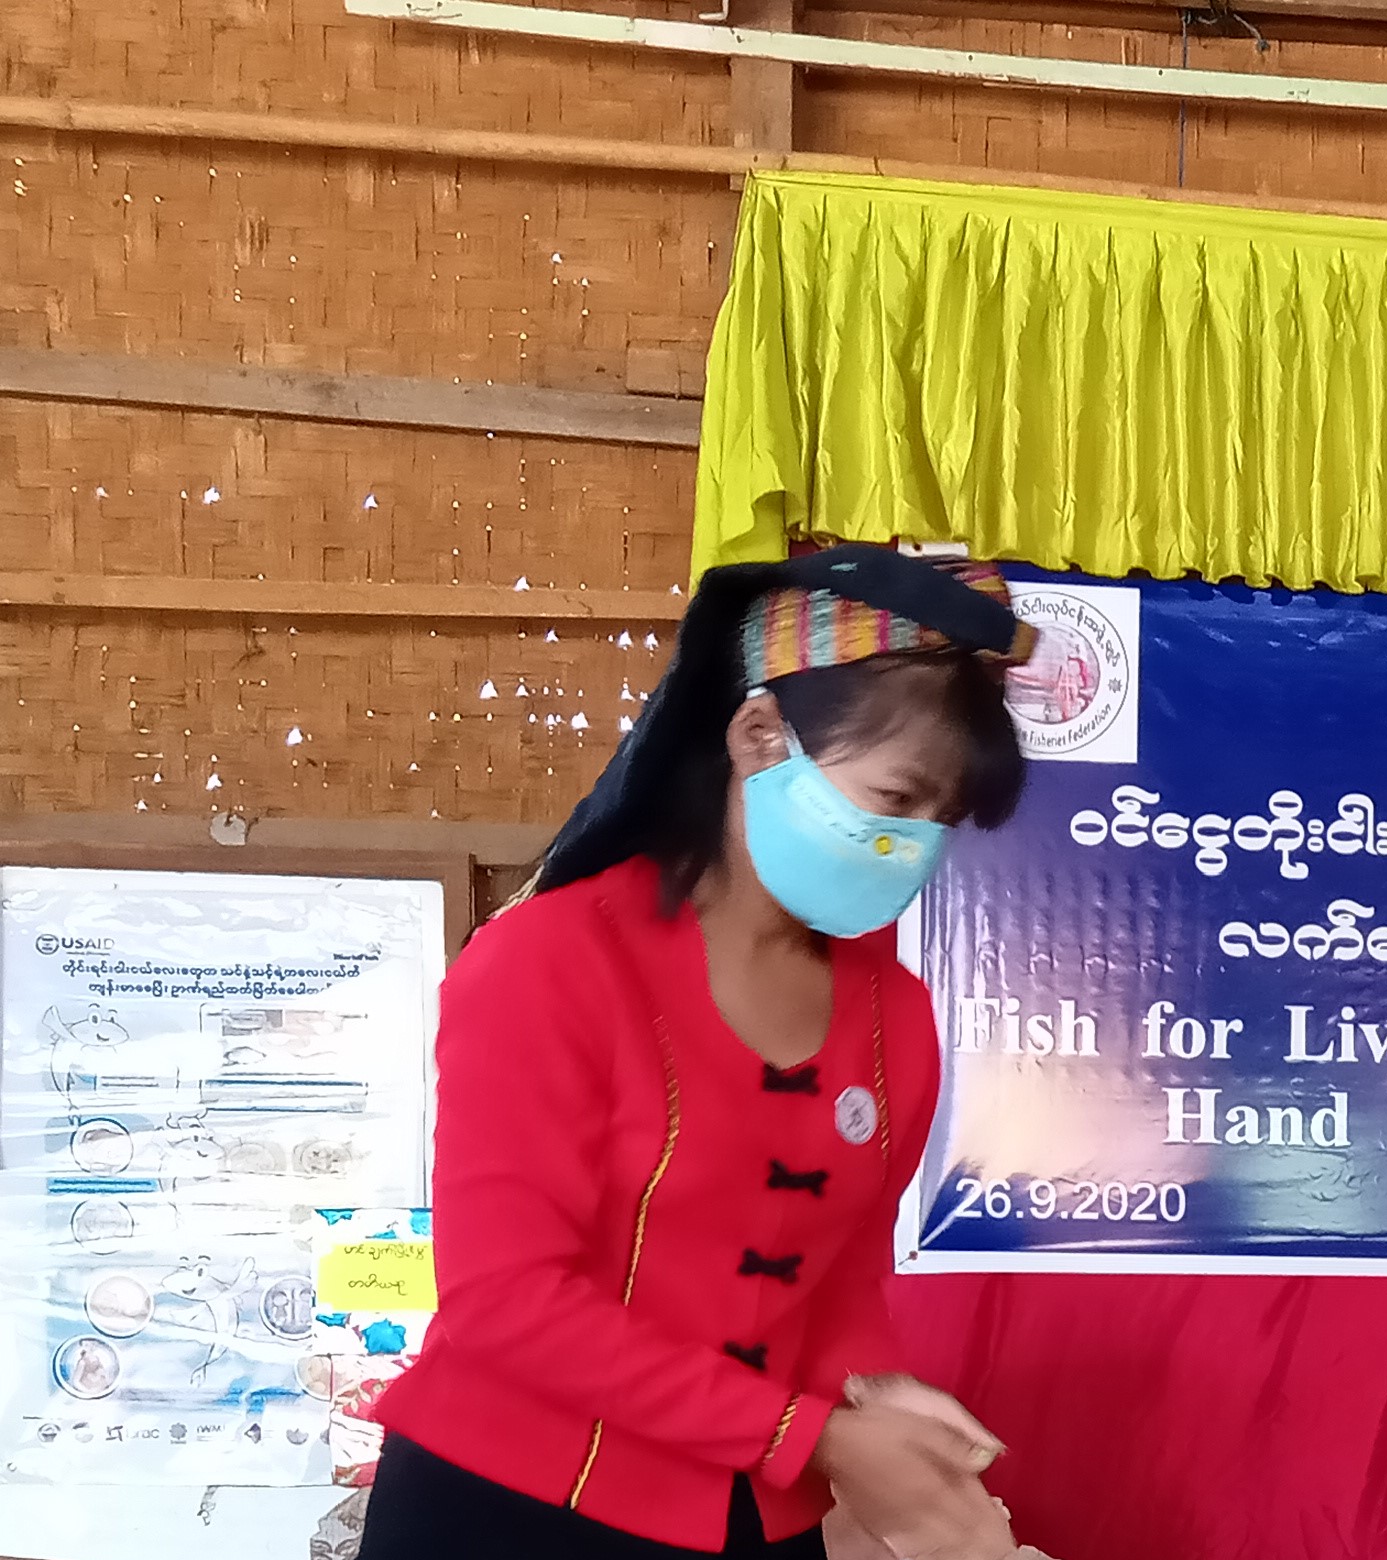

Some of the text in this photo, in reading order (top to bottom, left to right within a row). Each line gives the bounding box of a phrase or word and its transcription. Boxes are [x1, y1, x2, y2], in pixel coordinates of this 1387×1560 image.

[61, 936, 115, 951] USAID
[953, 996, 1100, 1057] Fish
[1141, 1001, 1244, 1060] for
[1164, 1087, 1352, 1150] Hand
[954, 1177, 1187, 1222] 26.9.2020
